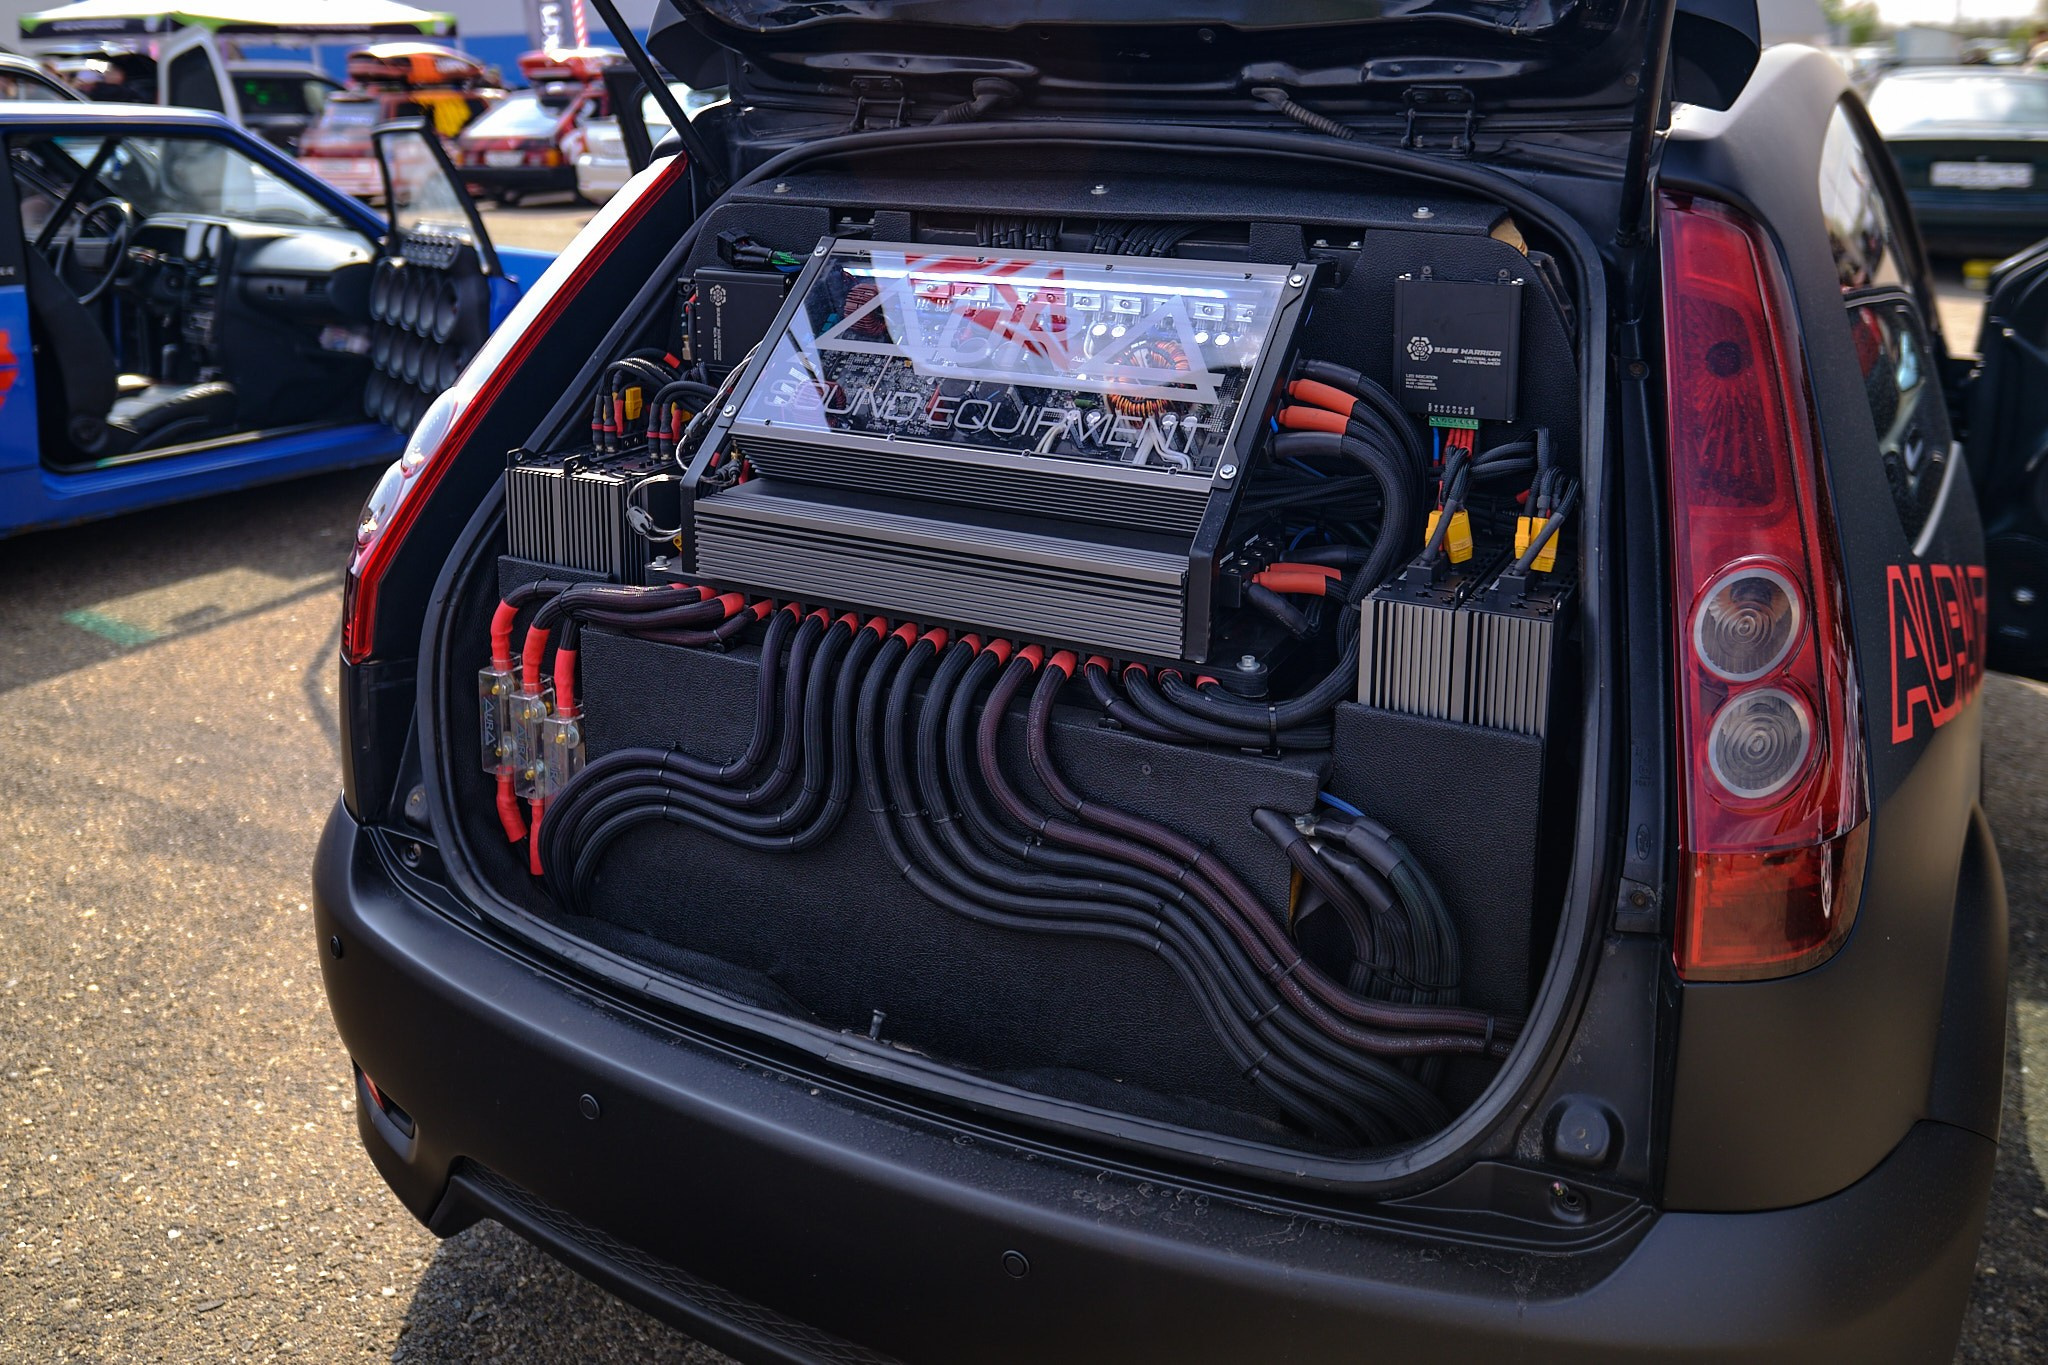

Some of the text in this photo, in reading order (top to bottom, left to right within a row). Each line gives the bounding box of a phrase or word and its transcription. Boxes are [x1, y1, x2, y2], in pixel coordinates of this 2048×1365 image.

[806, 272, 1226, 405] AURA
[1461, 348, 1502, 357] WARRIOR
[764, 379, 1214, 454] SOUND EQUIPMENT
[483, 696, 496, 746] AURA
